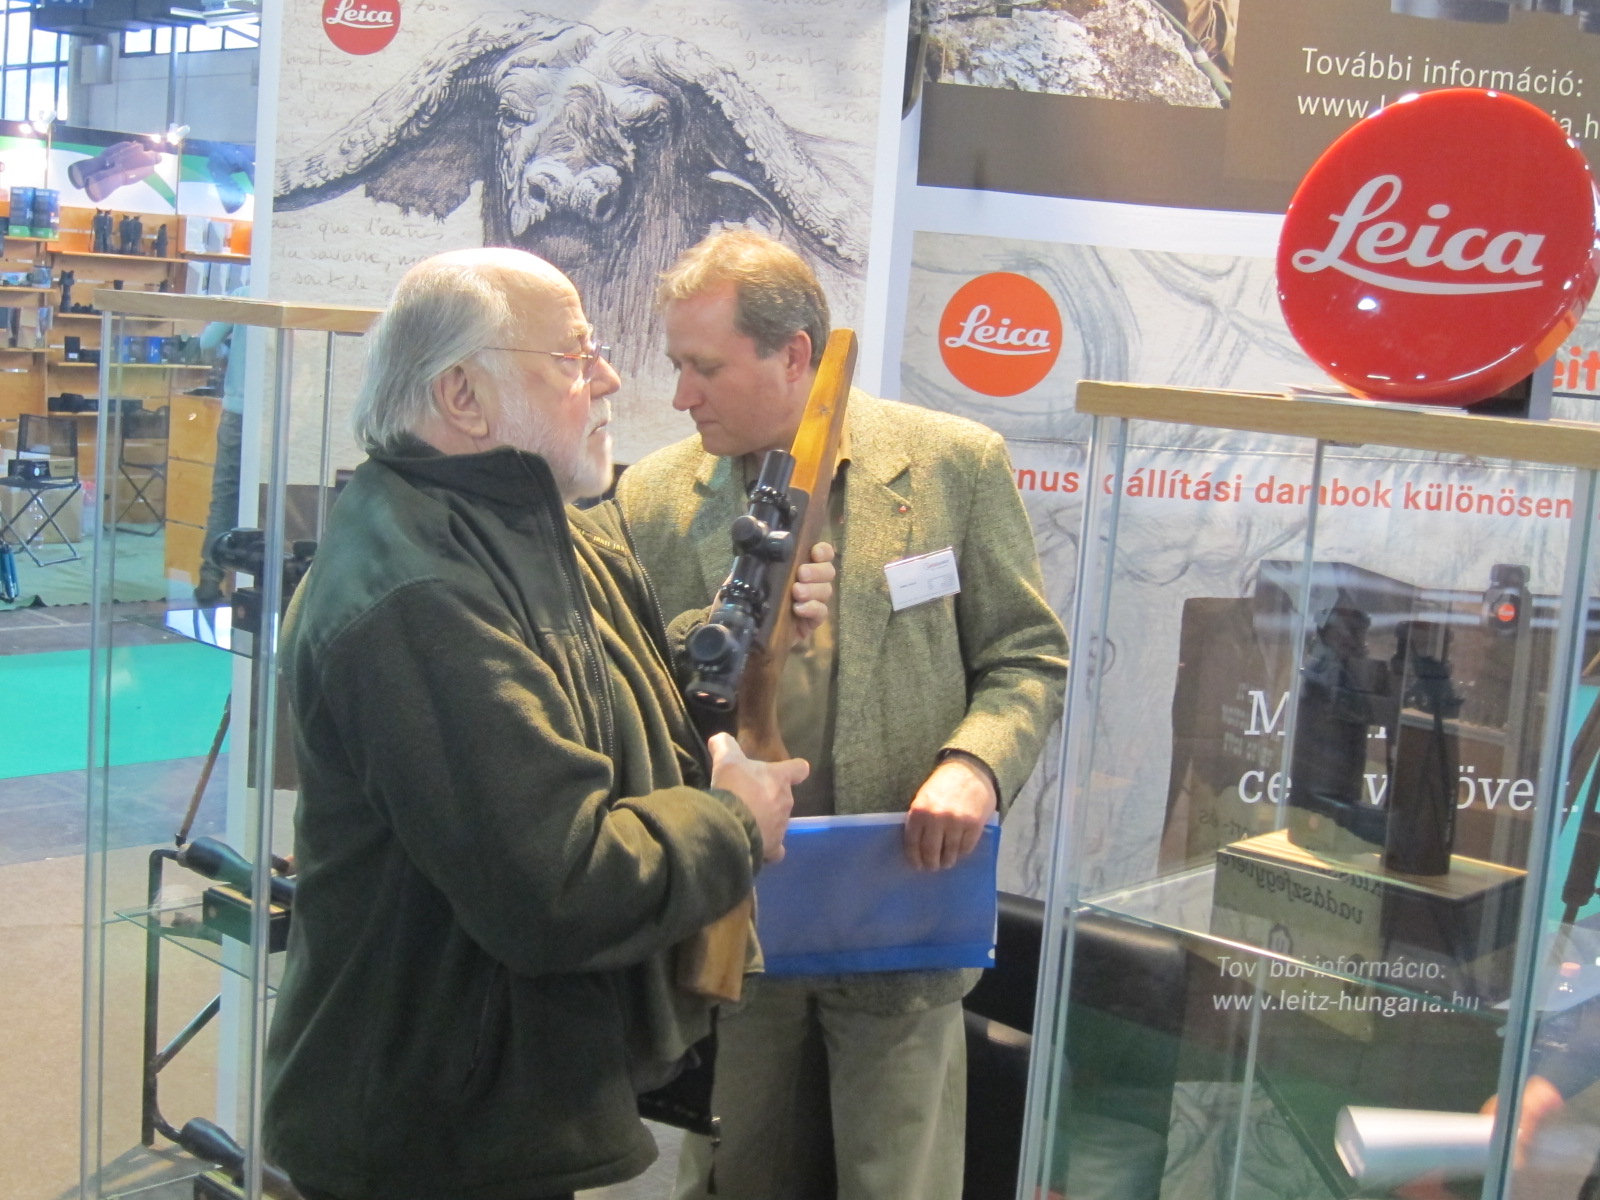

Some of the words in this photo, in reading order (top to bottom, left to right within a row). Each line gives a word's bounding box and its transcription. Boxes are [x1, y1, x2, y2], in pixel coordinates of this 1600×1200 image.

[326, 0, 394, 28] Leica
[1302, 47, 1413, 82] További
[1422, 57, 1584, 97] információ:
[1292, 174, 1545, 294] Leica
[944, 304, 1051, 355] Leica
[1403, 482, 1573, 519] különösen
